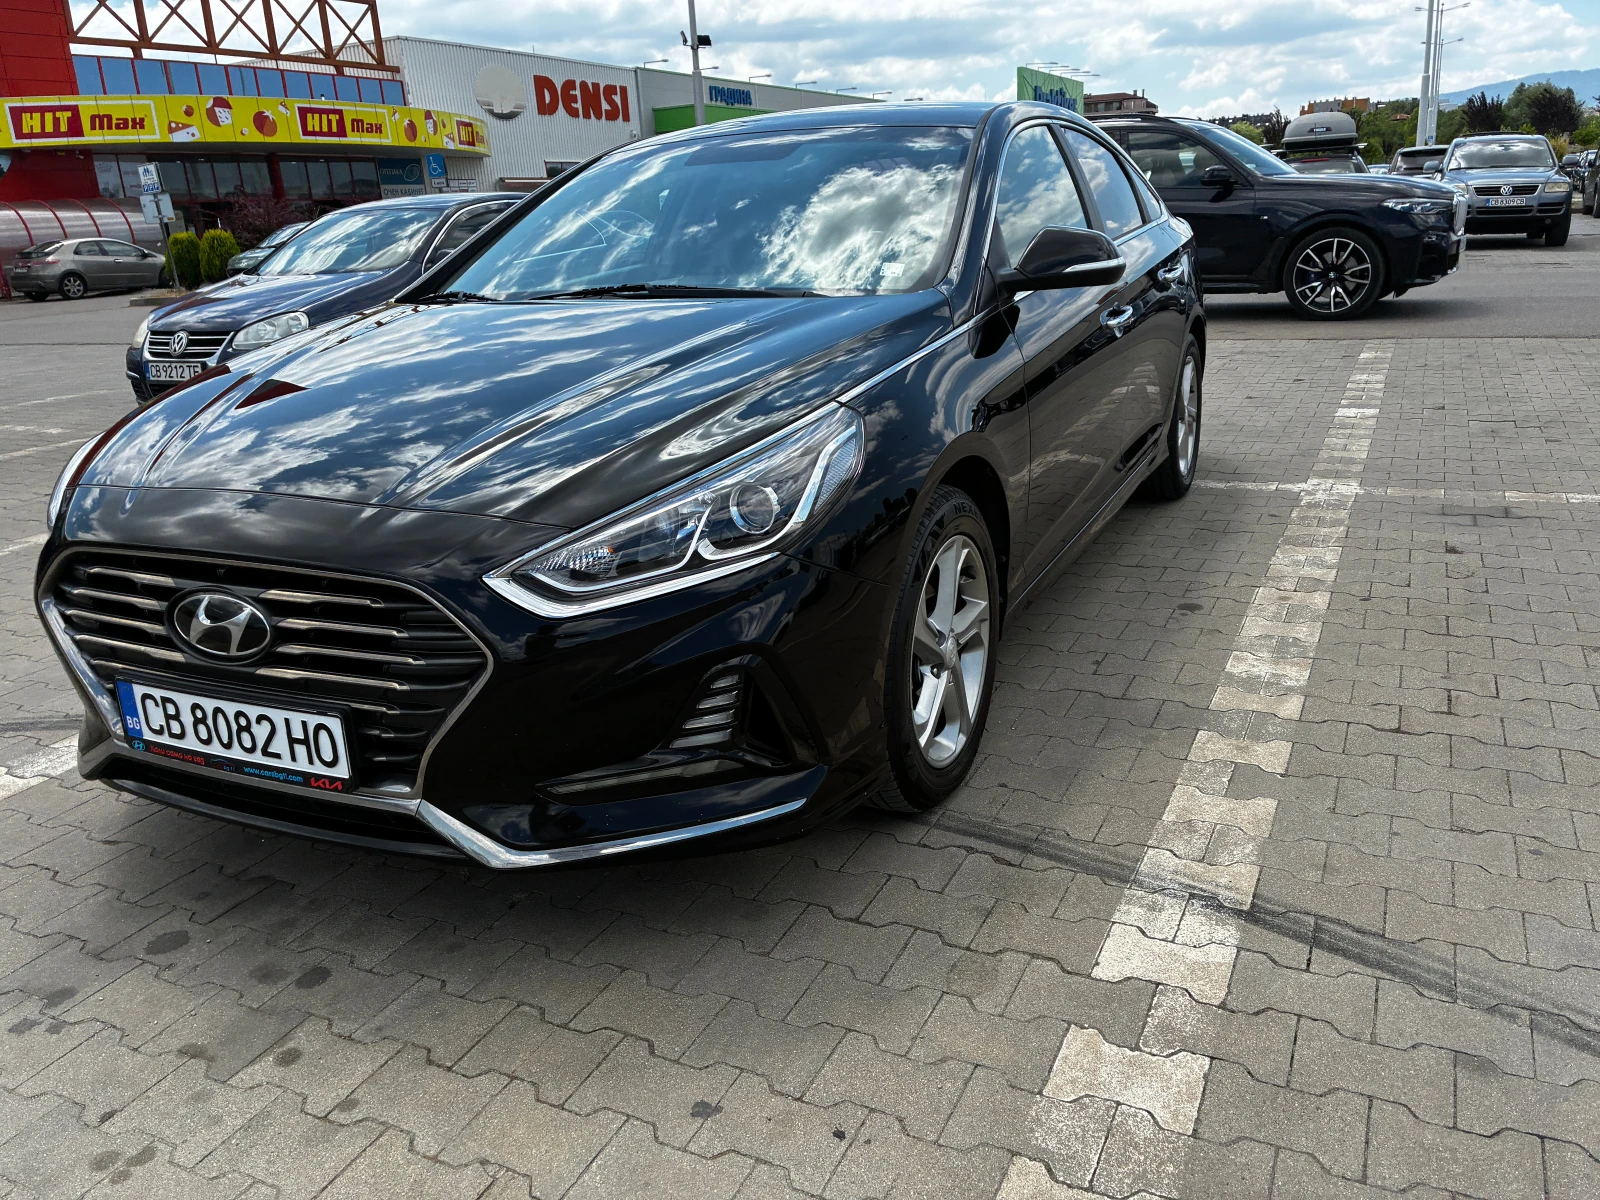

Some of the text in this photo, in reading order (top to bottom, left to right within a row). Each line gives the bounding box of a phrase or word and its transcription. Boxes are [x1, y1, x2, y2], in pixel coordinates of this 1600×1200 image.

[533, 75, 630, 122] DENSI
[709, 85, 752, 106] ГРАДИНА
[22, 111, 146, 133] HIT Max
[307, 113, 383, 134] HIT Max
[460, 125, 472, 142] HIT
[162, 364, 185, 379] 9212
[126, 715, 141, 730] BG
[140, 692, 339, 769] CB 8082 HO
